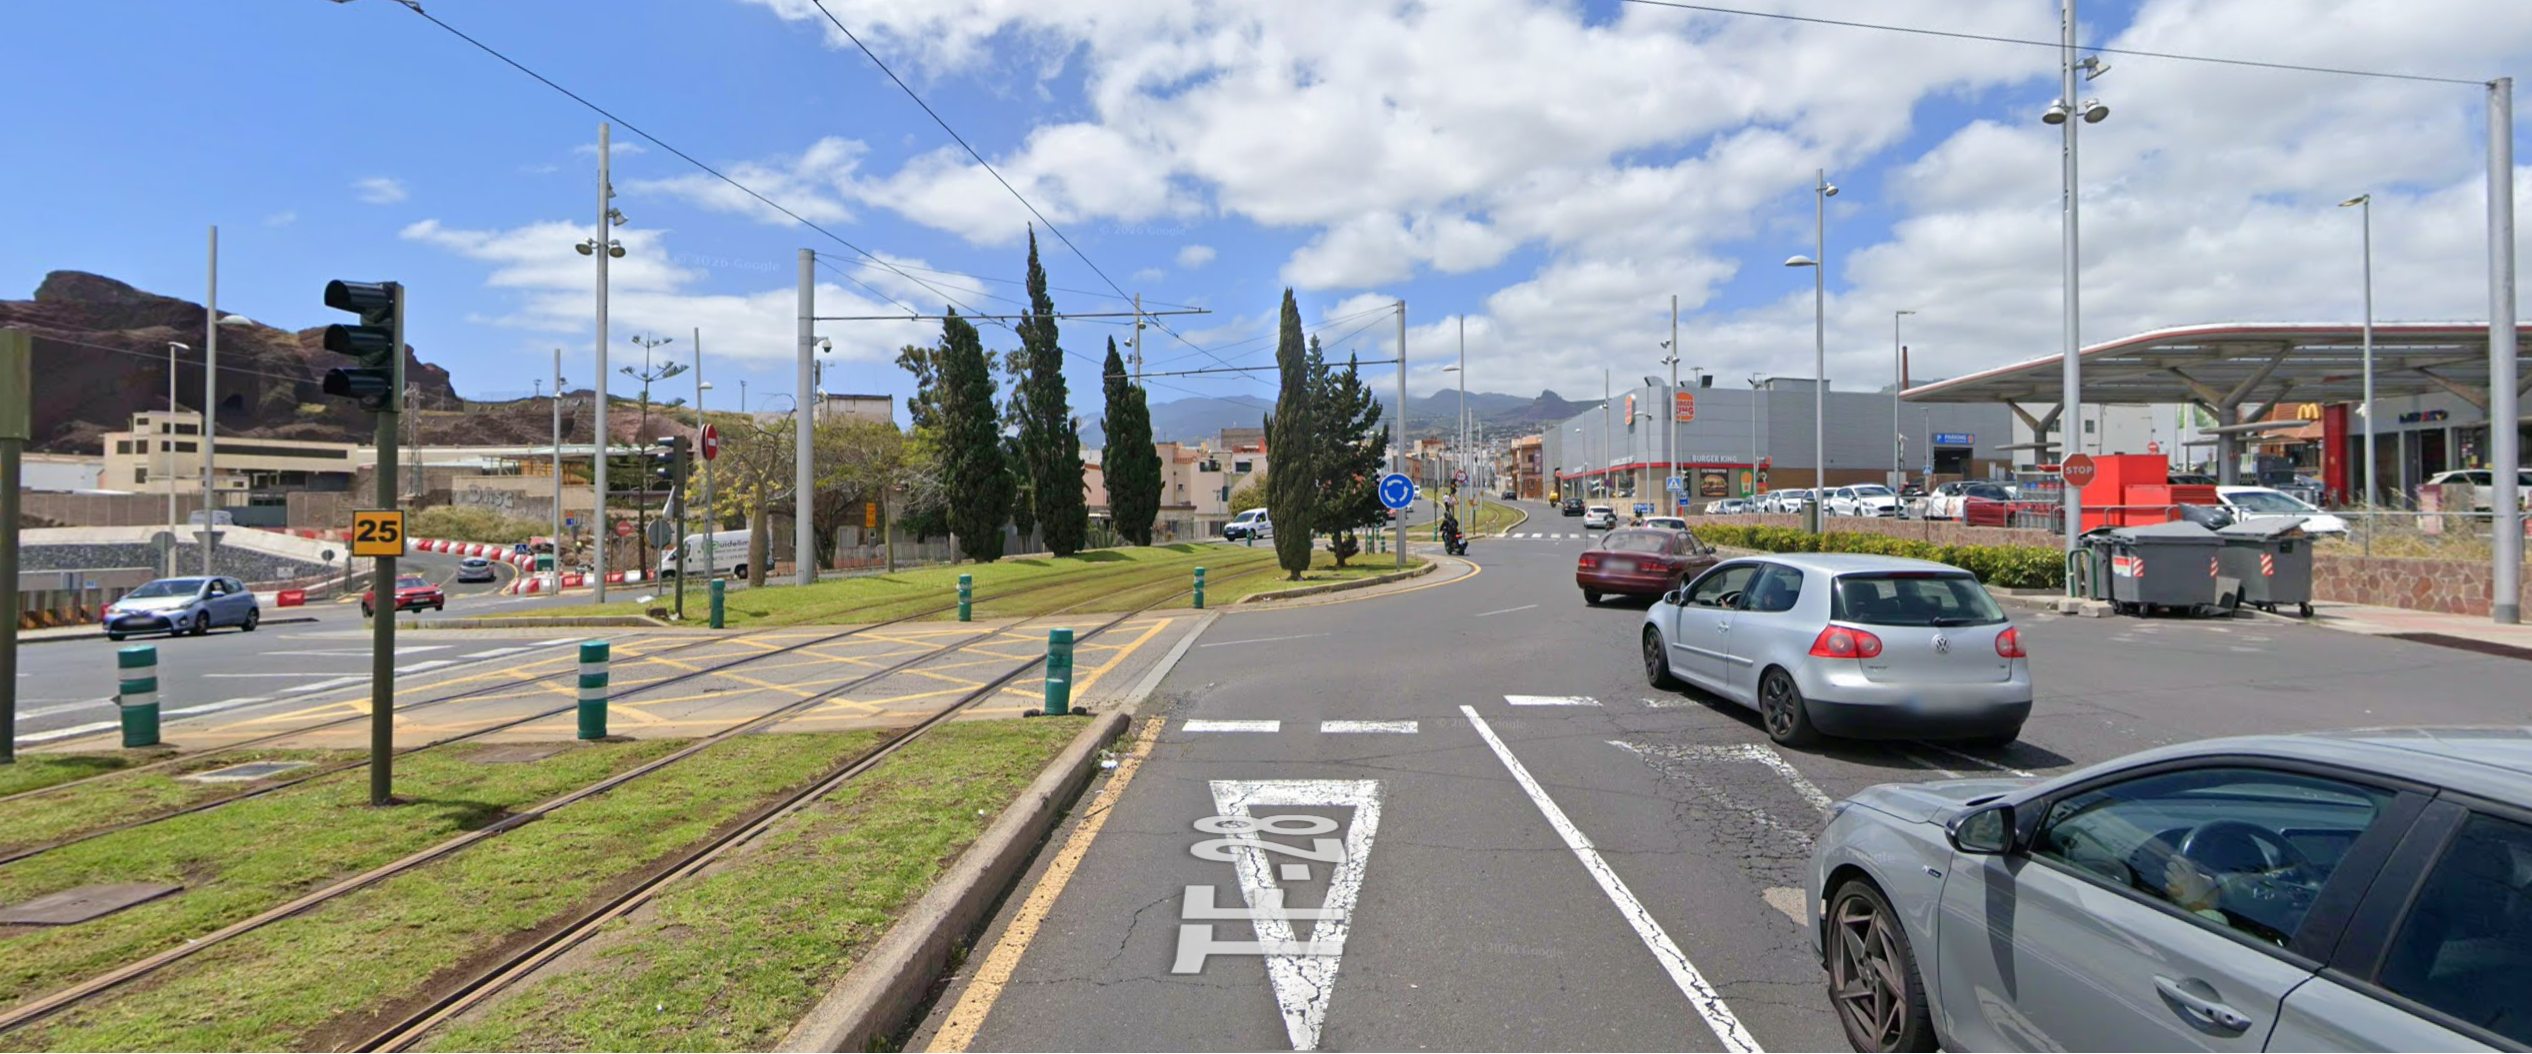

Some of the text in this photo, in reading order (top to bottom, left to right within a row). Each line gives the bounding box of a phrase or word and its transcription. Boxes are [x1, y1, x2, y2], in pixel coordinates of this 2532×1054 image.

[1692, 454, 1738, 463] BURGER KING
[2065, 465, 2093, 475] STOP
[357, 519, 398, 543] 25
